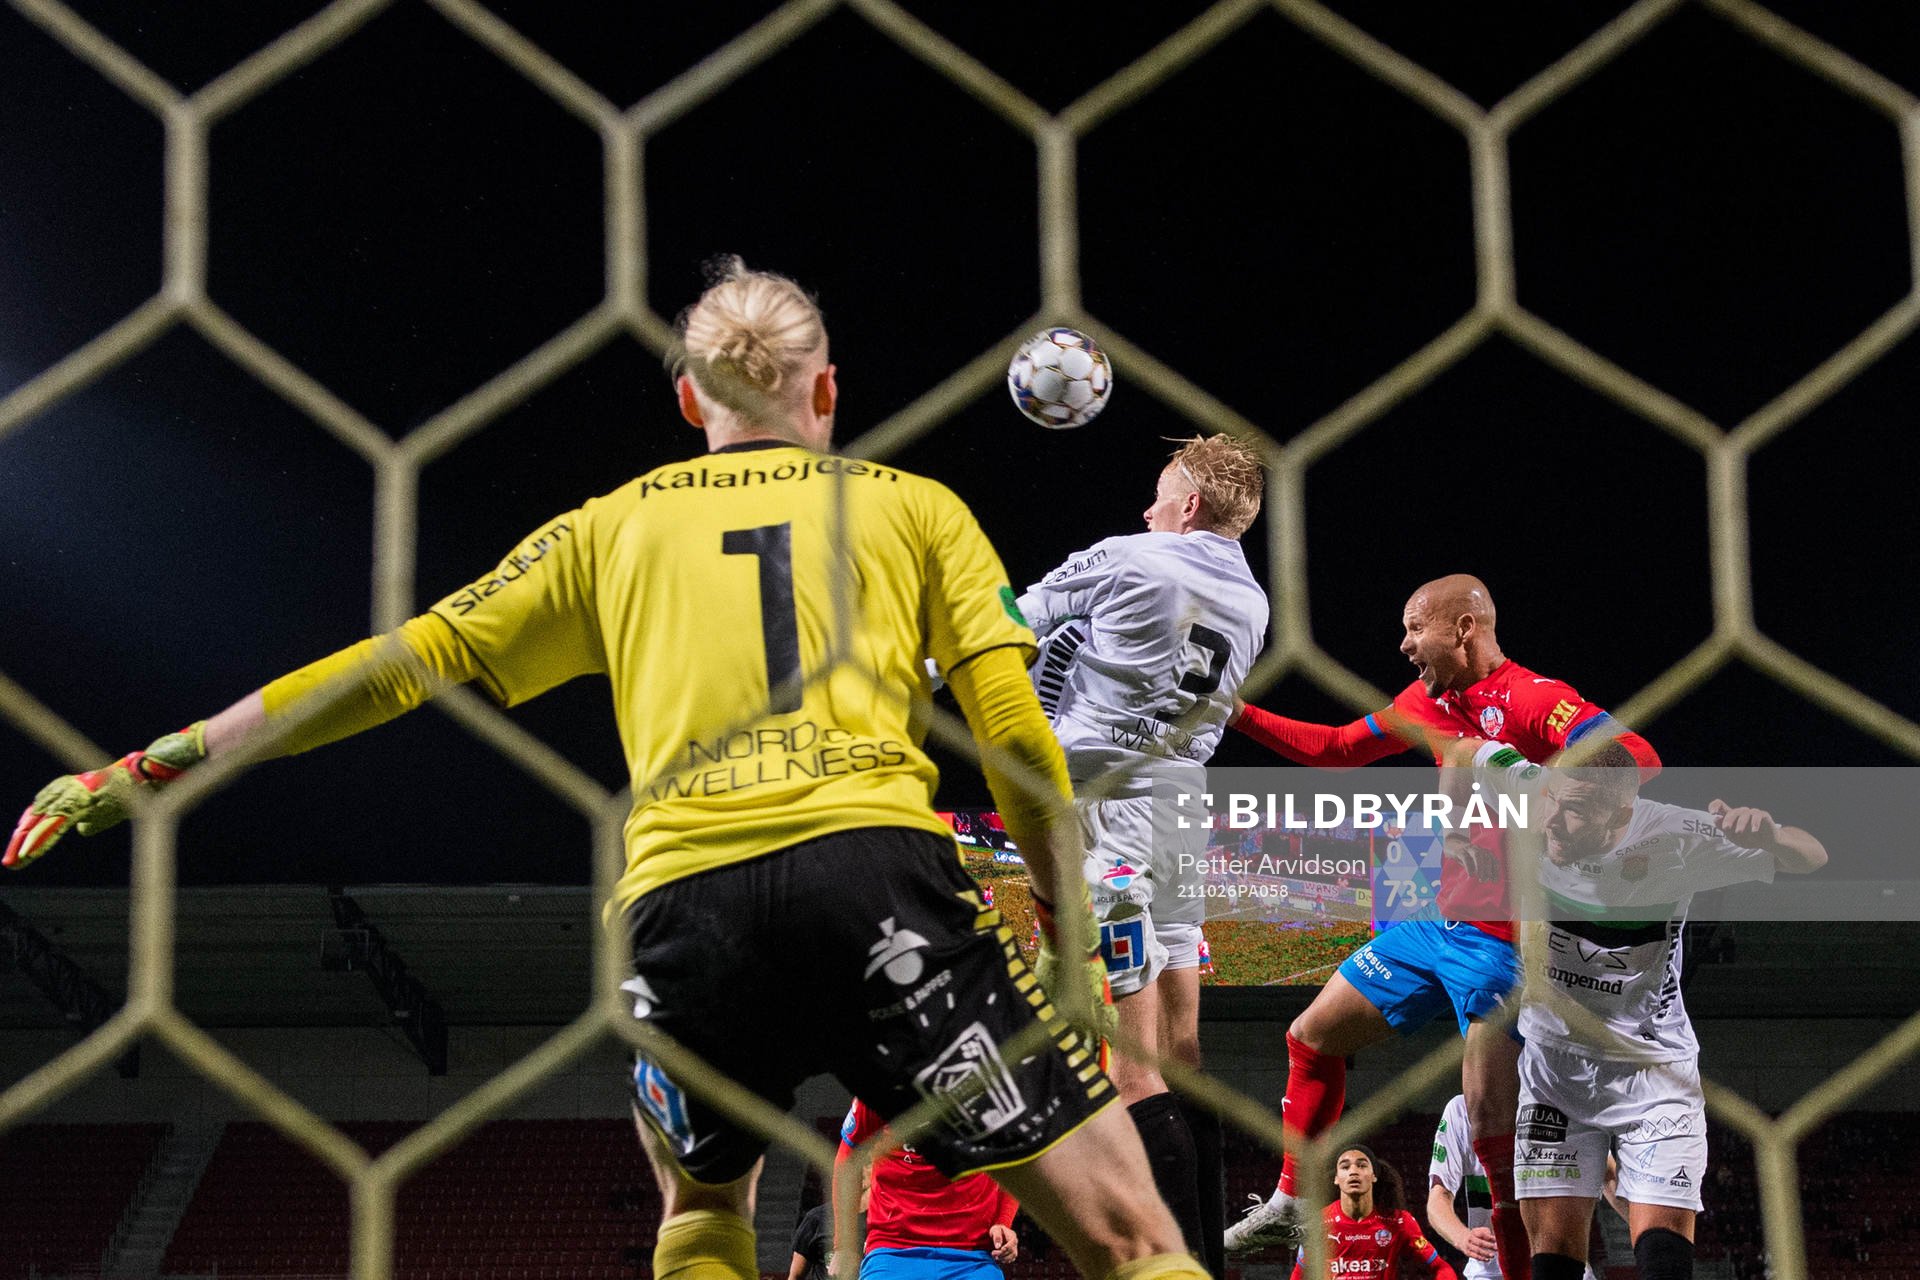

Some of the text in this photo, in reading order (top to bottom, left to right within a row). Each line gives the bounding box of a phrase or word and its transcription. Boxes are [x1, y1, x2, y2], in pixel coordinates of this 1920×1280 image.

[641, 458, 898, 499] Kalahöjden
[452, 523, 572, 616] stadium
[1045, 549, 1107, 584] adium
[721, 520, 803, 716] 1
[688, 721, 857, 768] NORDC
[650, 740, 906, 801] WELLNESS
[1615, 836, 1660, 857] SALDO
[1353, 952, 1375, 979] Bank
[1361, 945, 1393, 980] Resurs
[1526, 1147, 1578, 1161] Ekstrand
[1565, 1168, 1582, 1178] AB
[1670, 1180, 1692, 1188] SELECT
[1331, 1257, 1371, 1274] akea
